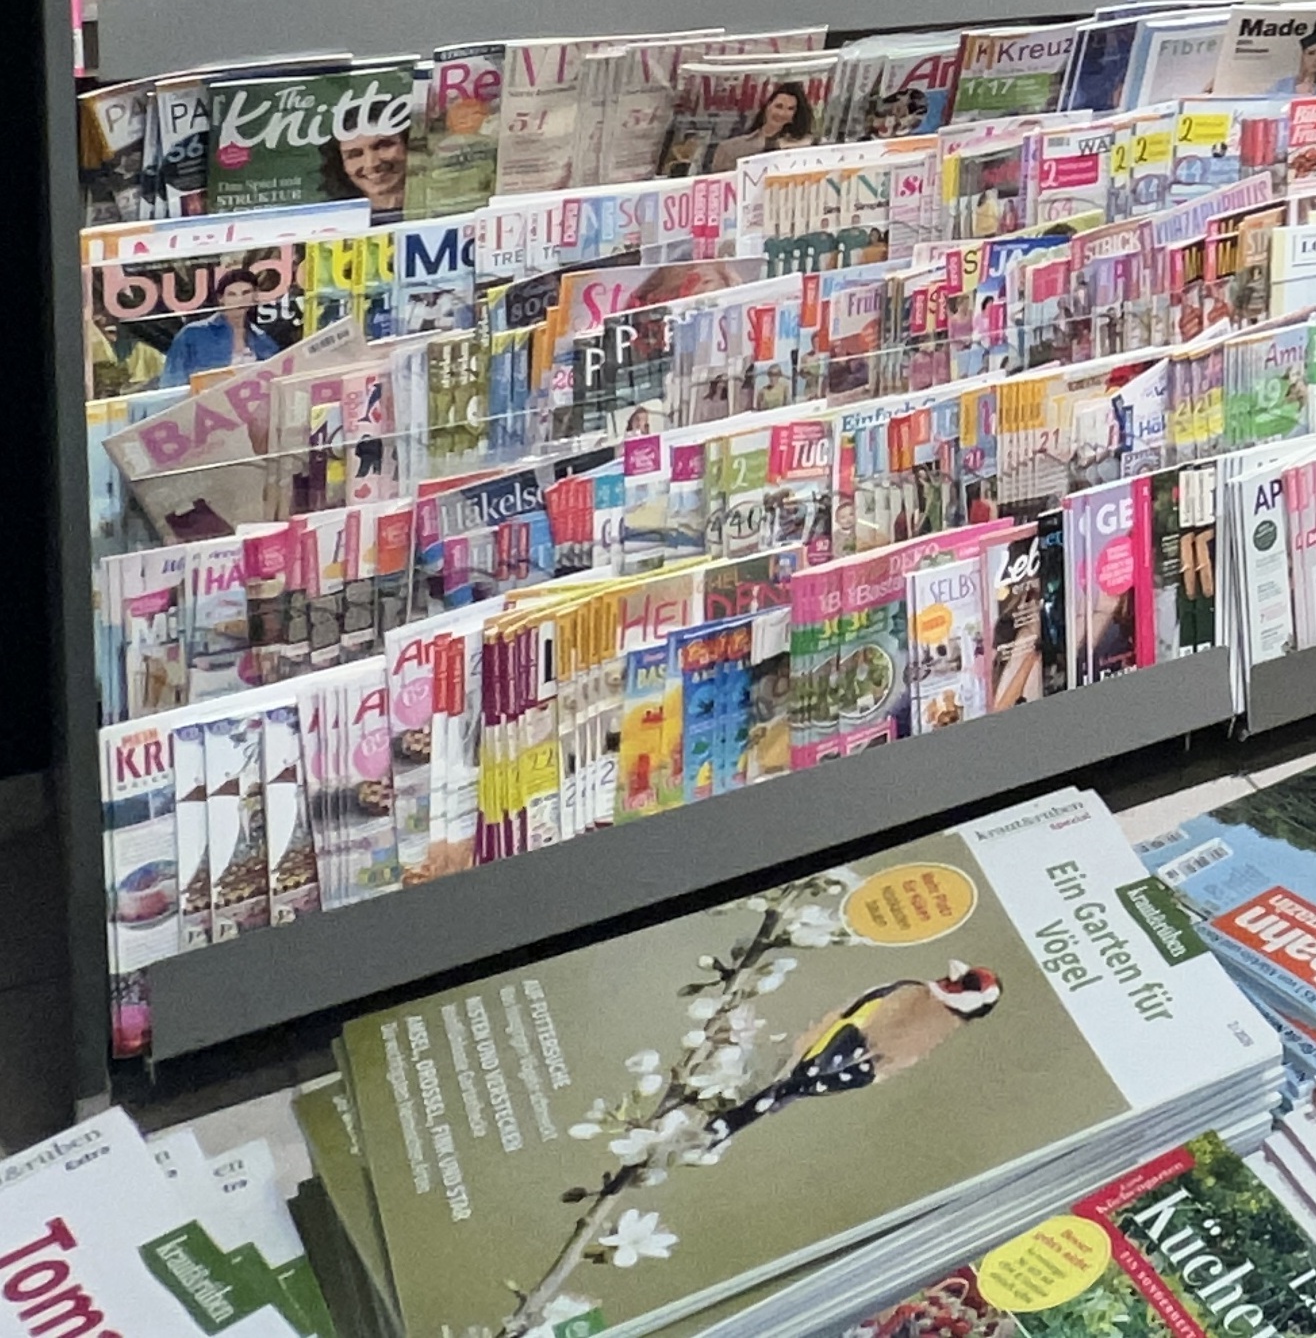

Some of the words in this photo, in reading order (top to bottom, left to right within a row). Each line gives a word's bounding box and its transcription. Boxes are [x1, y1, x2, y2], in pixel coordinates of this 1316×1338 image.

[999, 38, 1072, 64] Kreuz
[1238, 17, 1309, 38] Made
[138, 354, 297, 466] BABY
[1096, 498, 1134, 533] GE
[1036, 919, 1103, 992] Vögel
[1046, 860, 1086, 901] Ein
[1073, 902, 1142, 984] Garten
[1128, 982, 1173, 1022] für
[530, 1001, 571, 1090] FUTTERSUCHE
[416, 1059, 445, 1127] DROSSEL,
